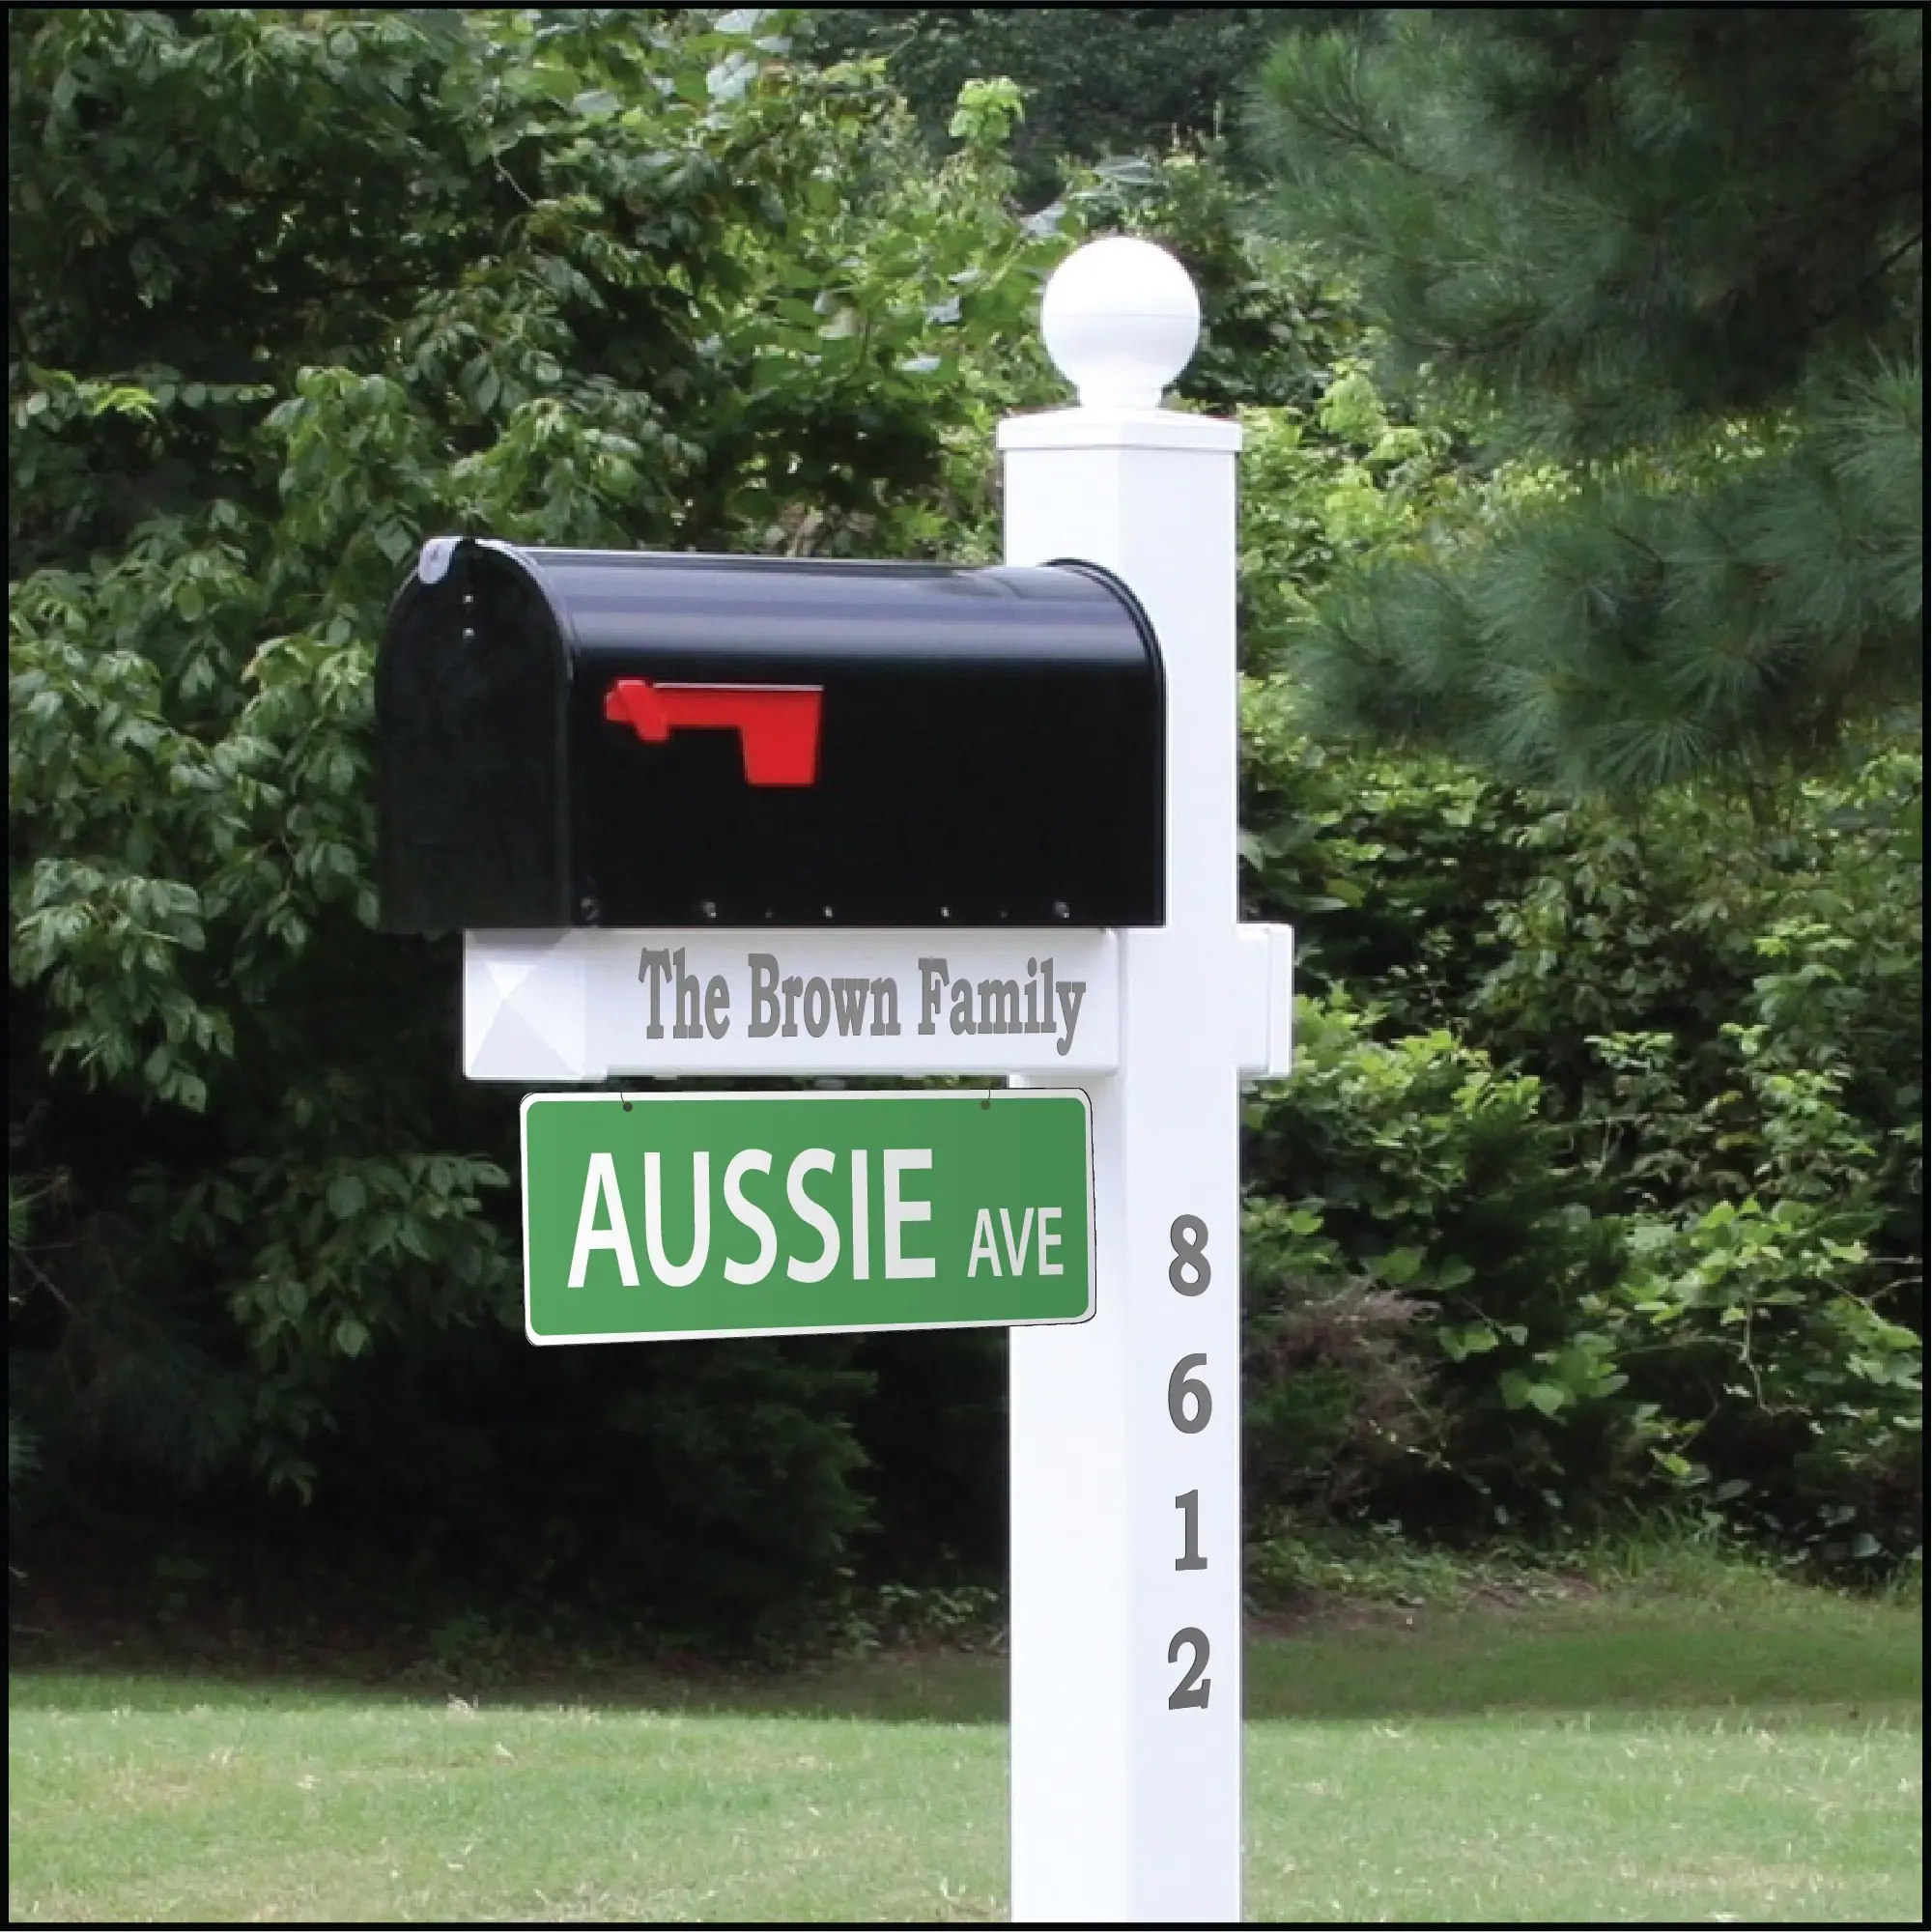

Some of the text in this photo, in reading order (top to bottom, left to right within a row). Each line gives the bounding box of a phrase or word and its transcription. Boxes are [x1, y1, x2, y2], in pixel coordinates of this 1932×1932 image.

[639, 947, 1087, 1057] The Brown Family
[567, 1148, 1064, 1290] AUSSIE AVE
